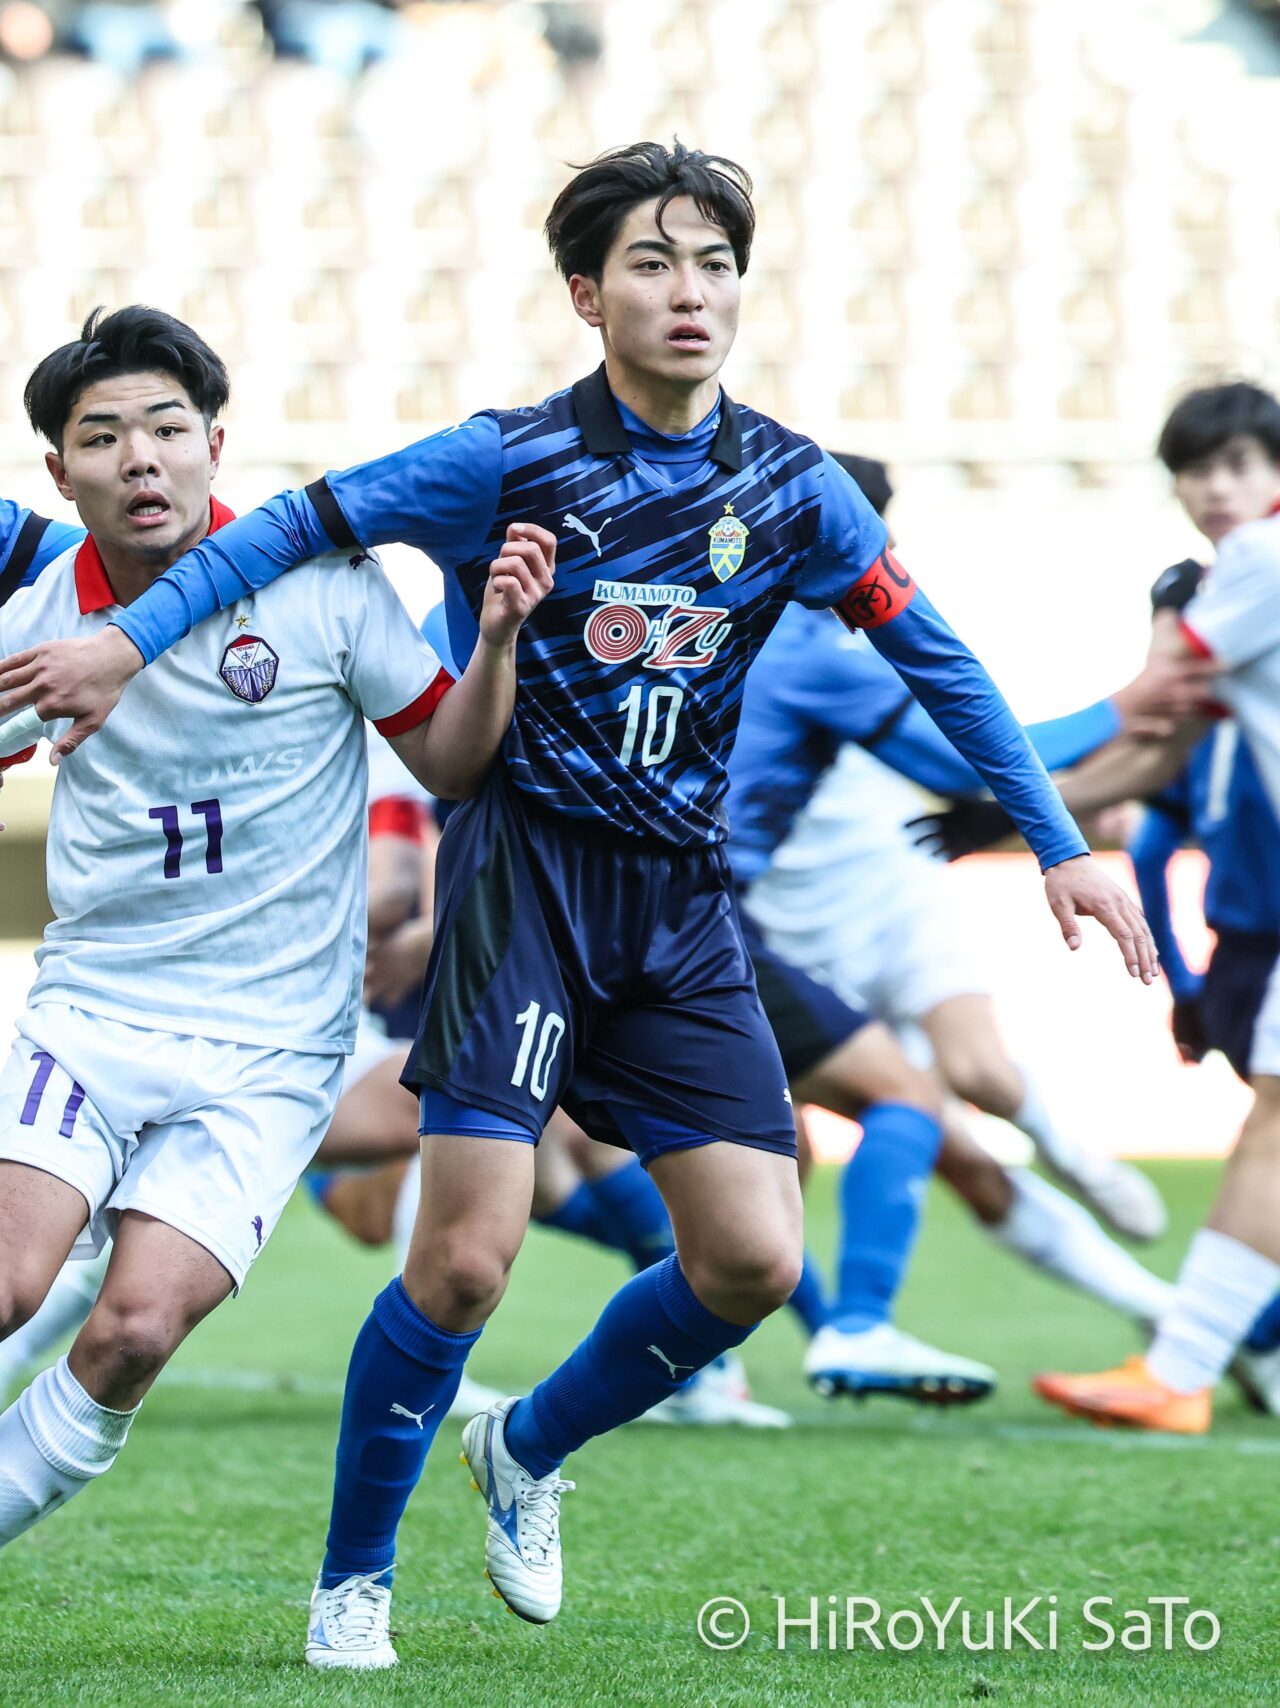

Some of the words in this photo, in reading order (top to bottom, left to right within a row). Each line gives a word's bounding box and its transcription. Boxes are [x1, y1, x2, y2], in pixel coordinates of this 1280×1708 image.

[596, 583, 694, 603] KUMAMOTO
[617, 685, 684, 767] 10
[148, 799, 224, 879] 11
[510, 1000, 566, 1101] 10
[20, 1051, 86, 1139] 11
